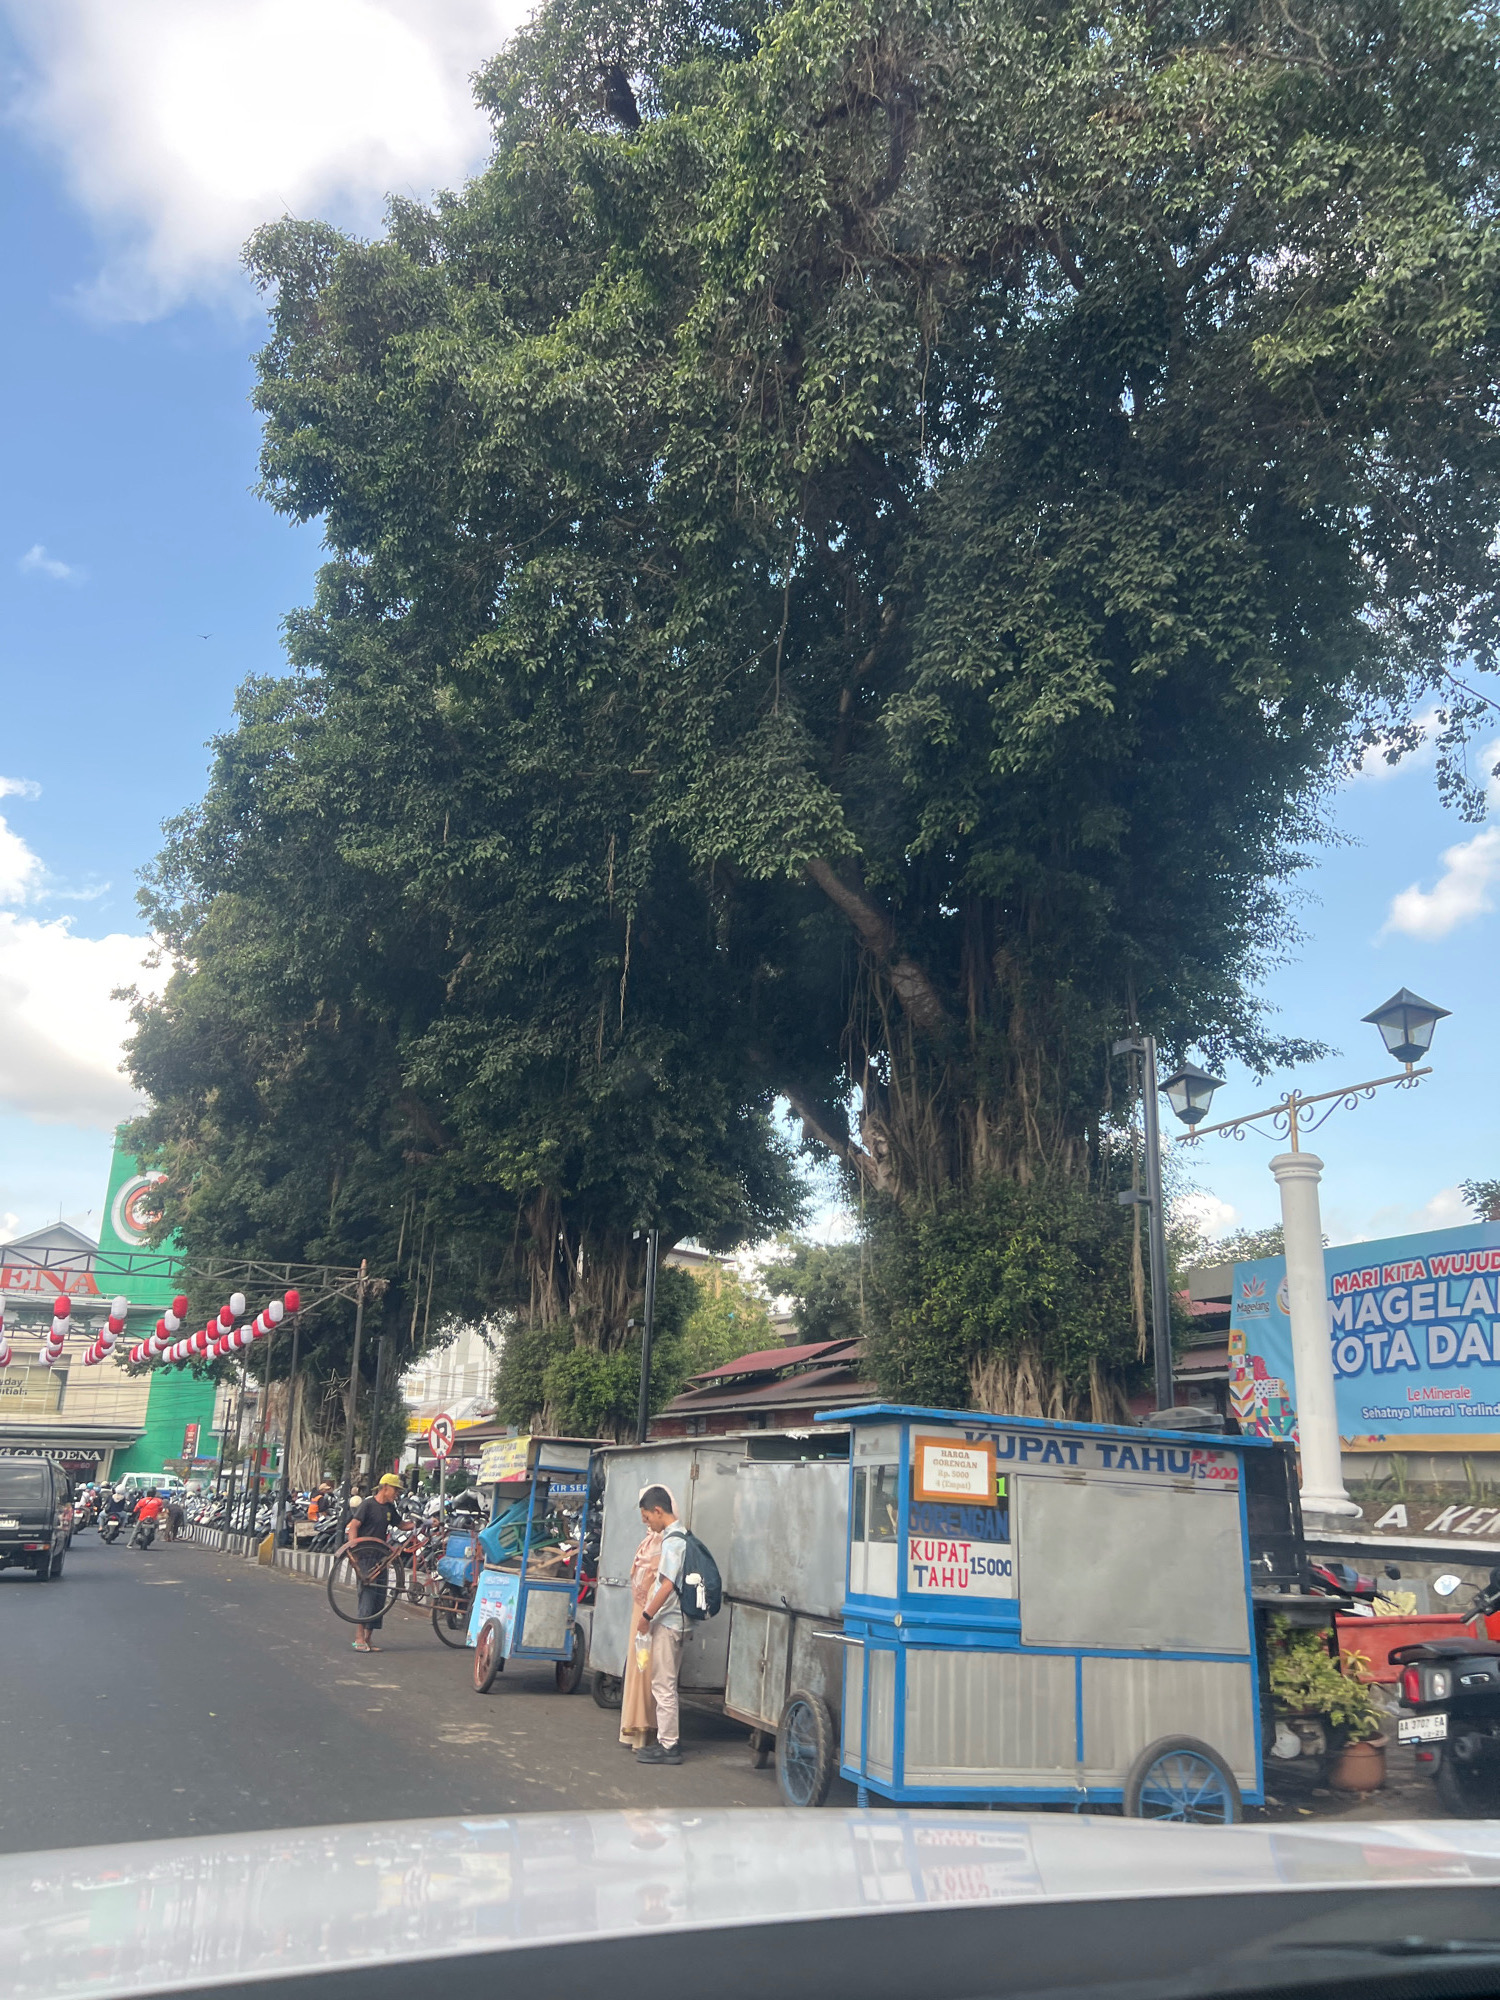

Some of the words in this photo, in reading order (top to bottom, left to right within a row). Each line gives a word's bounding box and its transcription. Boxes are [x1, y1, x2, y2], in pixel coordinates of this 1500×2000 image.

[1334, 1270, 1379, 1294] MARI
[1384, 1261, 1425, 1283] KITA
[1236, 1302, 1270, 1315] Magelang
[1327, 1277, 1500, 1333] MAGELA
[1407, 1387, 1420, 1401] Le
[1423, 1385, 1471, 1400] Minerale
[1362, 1407, 1410, 1420] Sehatnya
[1413, 1404, 1455, 1417] Mineral
[941, 1449, 970, 1460] HARGA
[1096, 1444, 1191, 1474] TAHU
[932, 1458, 978, 1470] GORENGAN
[951, 1470, 970, 1479] 5000
[910, 1539, 972, 1564] KUPAT
[970, 1557, 1012, 1577] 15000
[913, 1564, 969, 1589] TAHU
